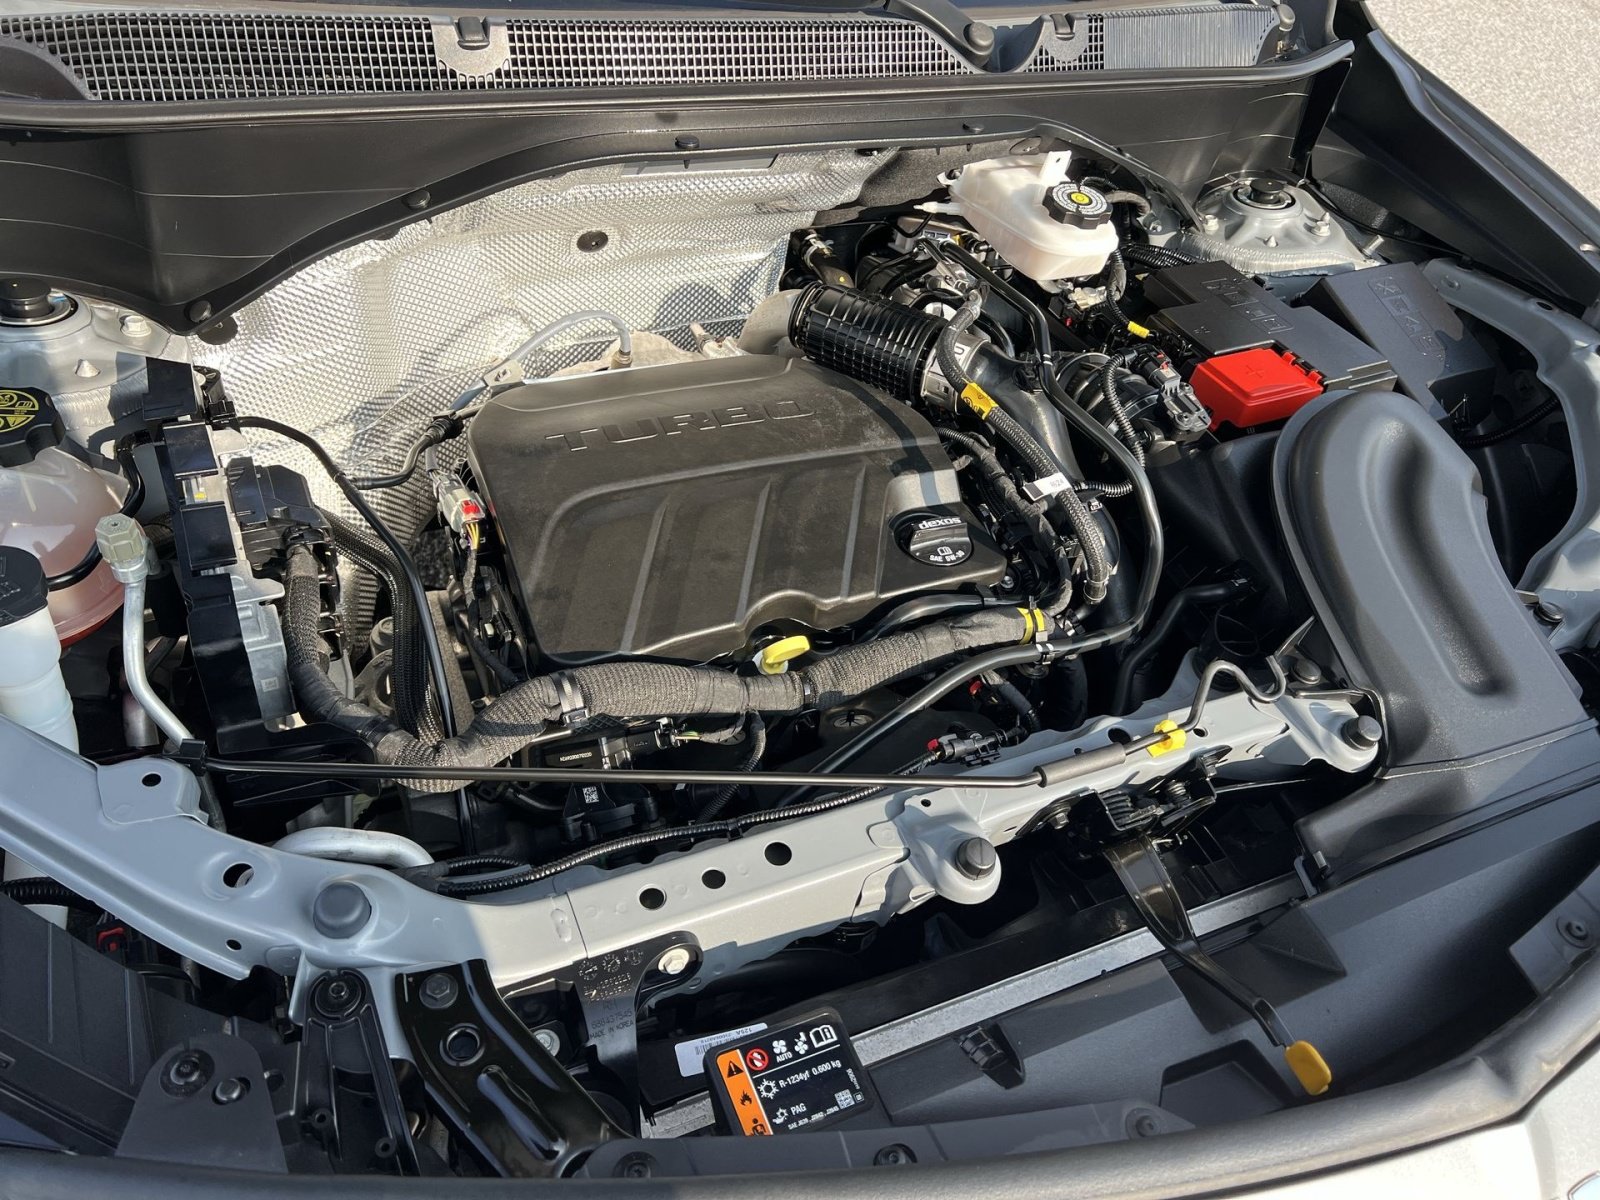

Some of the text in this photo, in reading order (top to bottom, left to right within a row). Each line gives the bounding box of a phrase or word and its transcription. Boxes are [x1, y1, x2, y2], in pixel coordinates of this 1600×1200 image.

[544, 400, 817, 452] TURBO
[918, 517, 962, 530] dexos
[929, 554, 944, 562] SAE
[776, 1052, 793, 1063] AUTO
[778, 1059, 842, 1088] R-1234yf 0.600 kg
[790, 1102, 807, 1116] PAG
